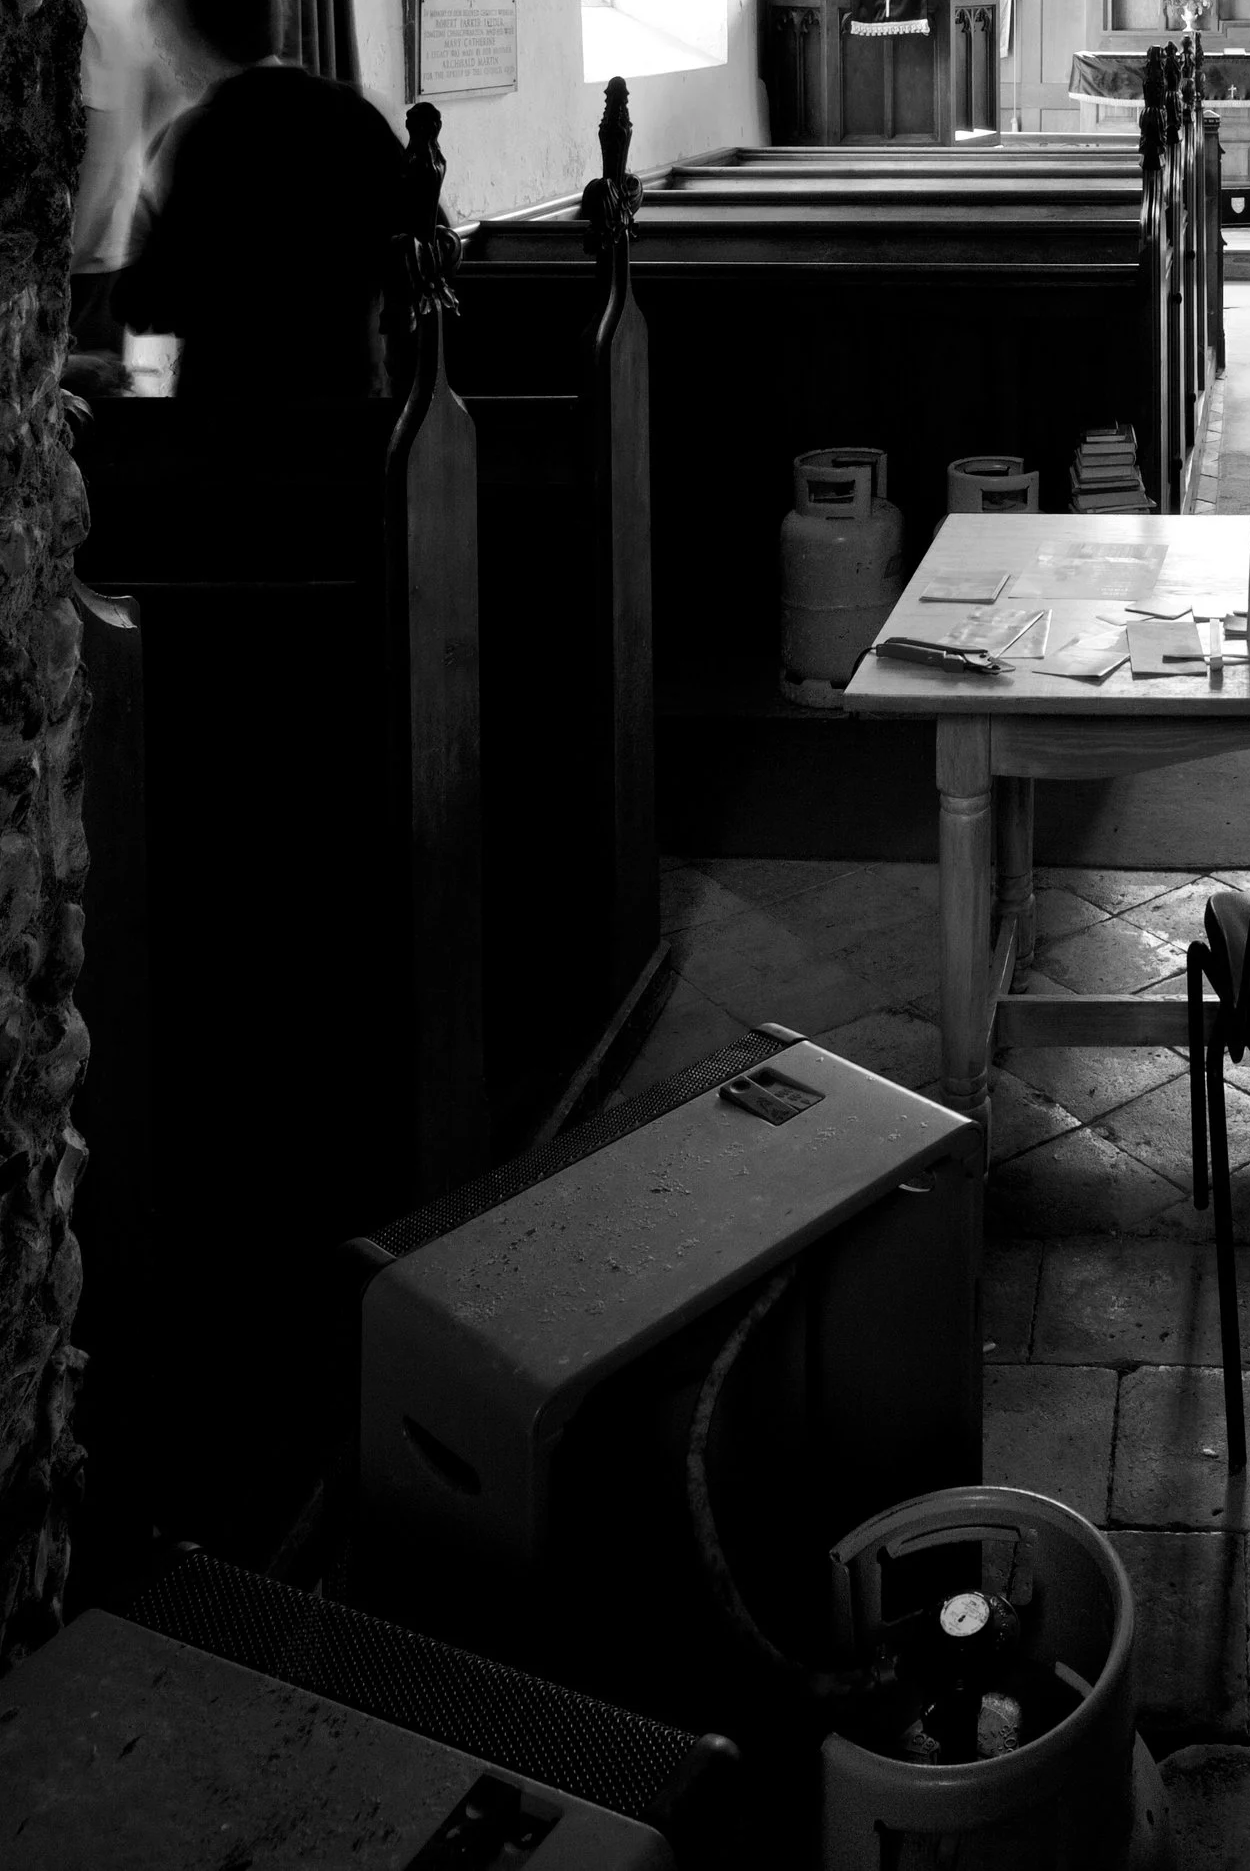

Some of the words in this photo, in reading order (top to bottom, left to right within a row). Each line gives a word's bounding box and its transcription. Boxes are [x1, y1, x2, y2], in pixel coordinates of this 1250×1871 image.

[435, 19, 457, 28] ROBERT
[444, 38, 461, 48] MARY
[464, 37, 495, 47] CATHERINE
[442, 58, 475, 69] ARCHIBALD
[478, 57, 499, 67] MARTIN
